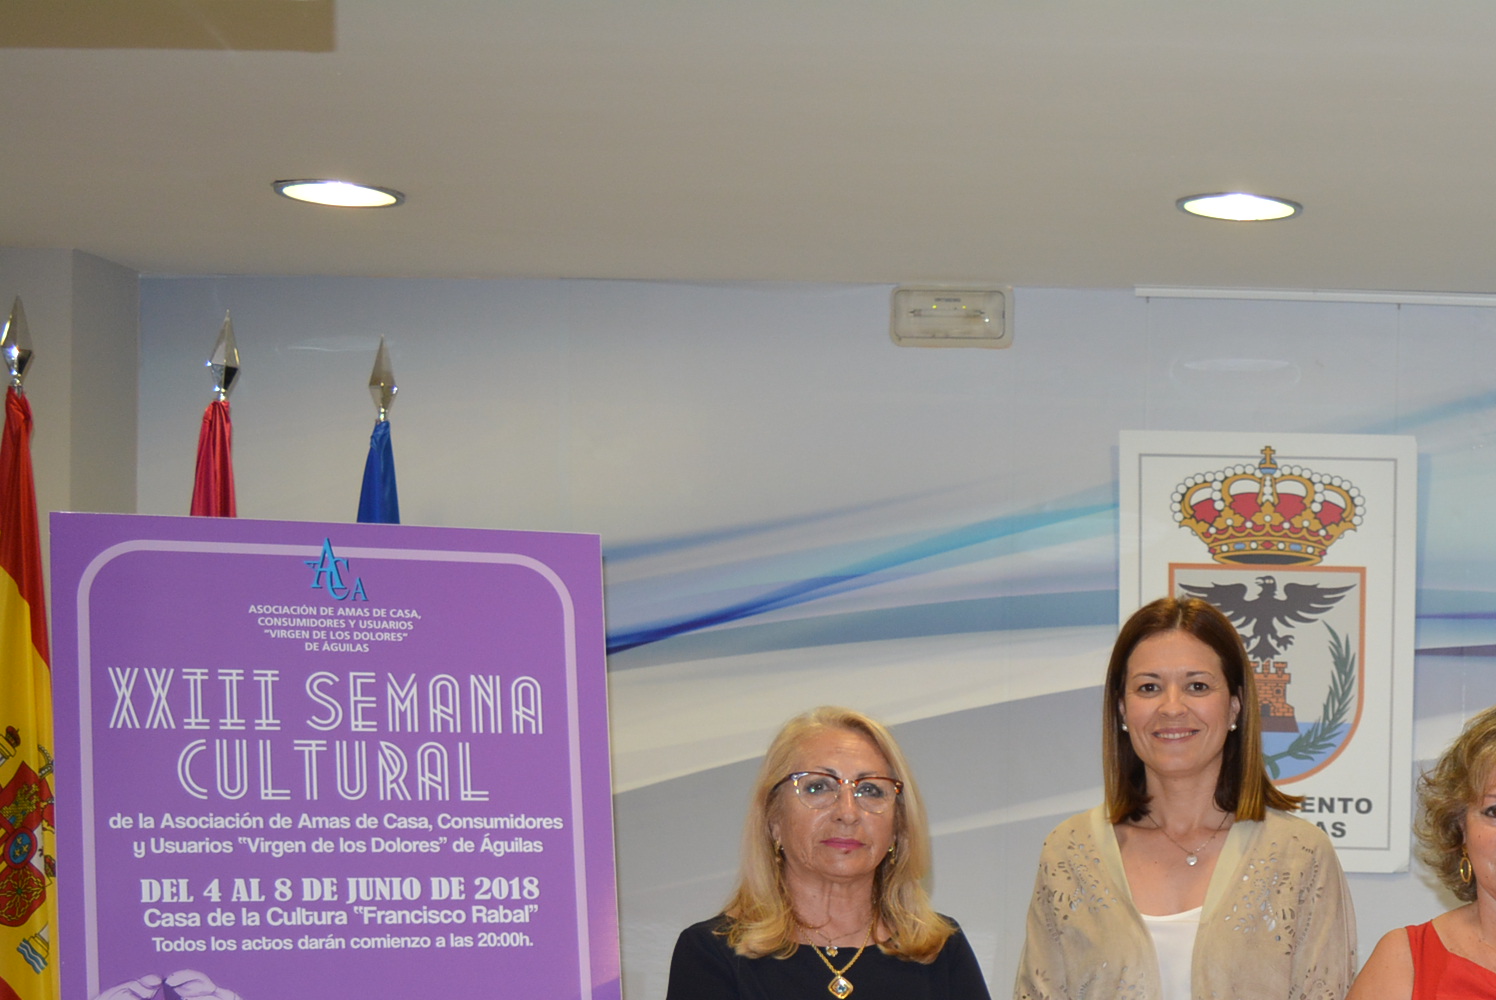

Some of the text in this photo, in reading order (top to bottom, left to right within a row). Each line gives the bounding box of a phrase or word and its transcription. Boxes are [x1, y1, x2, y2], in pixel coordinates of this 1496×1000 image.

[248, 604, 421, 619] ASOCIACIÓN DE AMAS DE CASA,
[257, 617, 414, 630] CONSUMIDORES Y USUARIOS
[312, 630, 327, 639] DE
[330, 631, 351, 640] LOS
[305, 641, 369, 653] DE ÁGUILAS
[108, 667, 543, 734] XXIII SEMANA
[177, 739, 489, 801] CULTURAL
[109, 812, 563, 832] de la Asociación de Amas de Casa, Consumidores
[133, 841, 145, 858] y
[150, 837, 233, 854] Usuarios
[311, 837, 335, 853] de
[339, 837, 367, 853] los
[452, 837, 475, 853] de
[480, 833, 543, 857] Águilas
[140, 876, 540, 904] DEL 4 AL 8 DE JUNIO DE 2018
[143, 908, 201, 928] Casa
[207, 908, 235, 927] de
[241, 907, 260, 926] la
[266, 907, 348, 926] Cultura
[151, 932, 534, 952] Todos los actos darán comienzo a las 20:00h.
